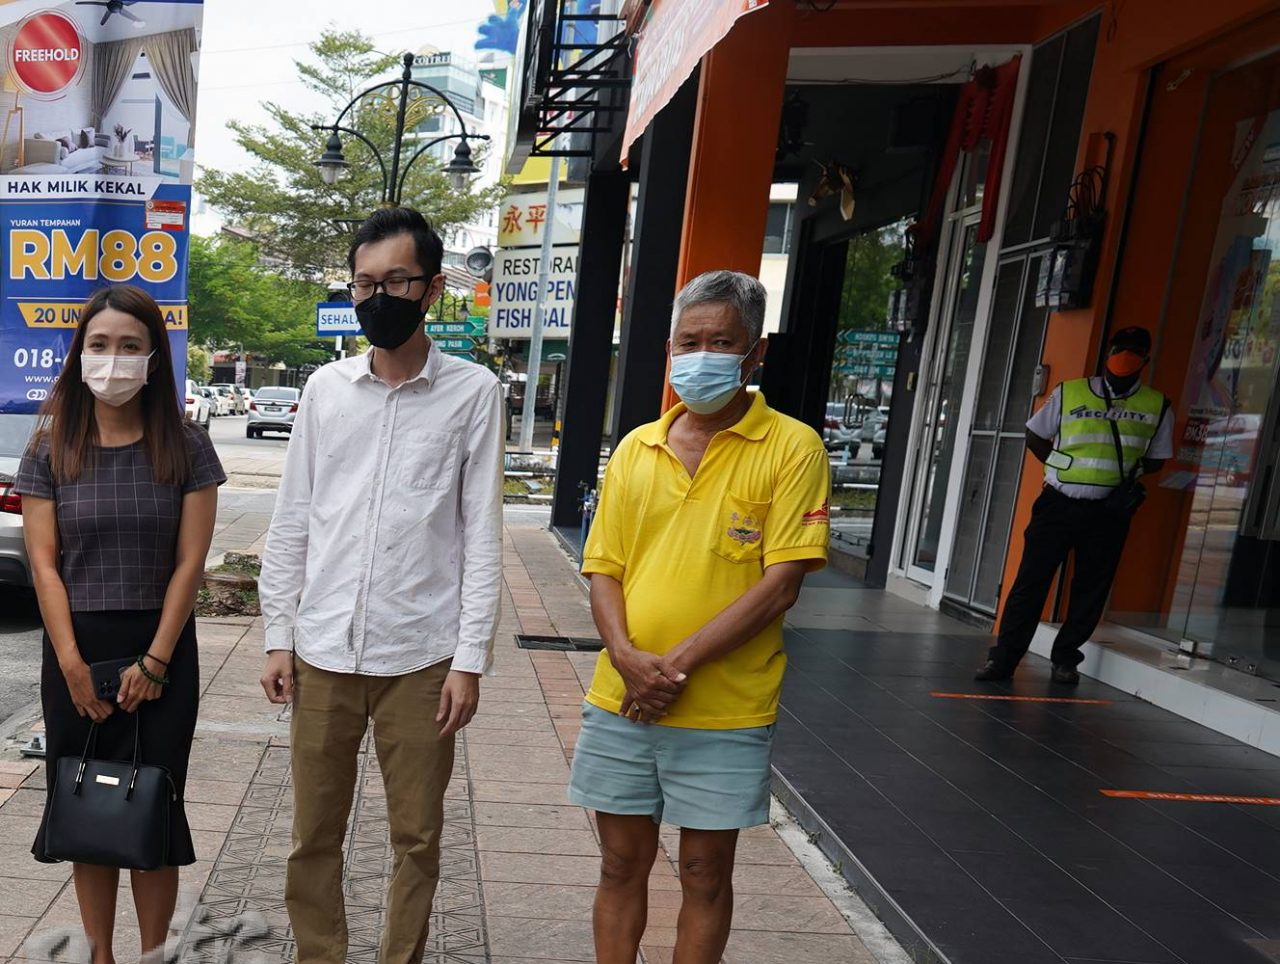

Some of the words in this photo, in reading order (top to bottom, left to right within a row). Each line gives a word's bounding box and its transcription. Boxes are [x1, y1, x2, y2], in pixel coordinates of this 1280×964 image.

[15, 48, 80, 62] FREEHOLD
[8, 181, 42, 194] HAK
[47, 181, 89, 193] MILIK
[94, 182, 146, 195] KEKAL
[40, 219, 81, 227] TEMPAHAN
[502, 204, 547, 234] 永平
[9, 229, 178, 283] RM88
[502, 256, 578, 276] RESTRA
[496, 281, 538, 303] YONG
[547, 280, 577, 301] PEN
[34, 307, 56, 323] 20
[61, 309, 82, 324] UN
[496, 307, 532, 328] FISH
[446, 324, 465, 332] KEROH
